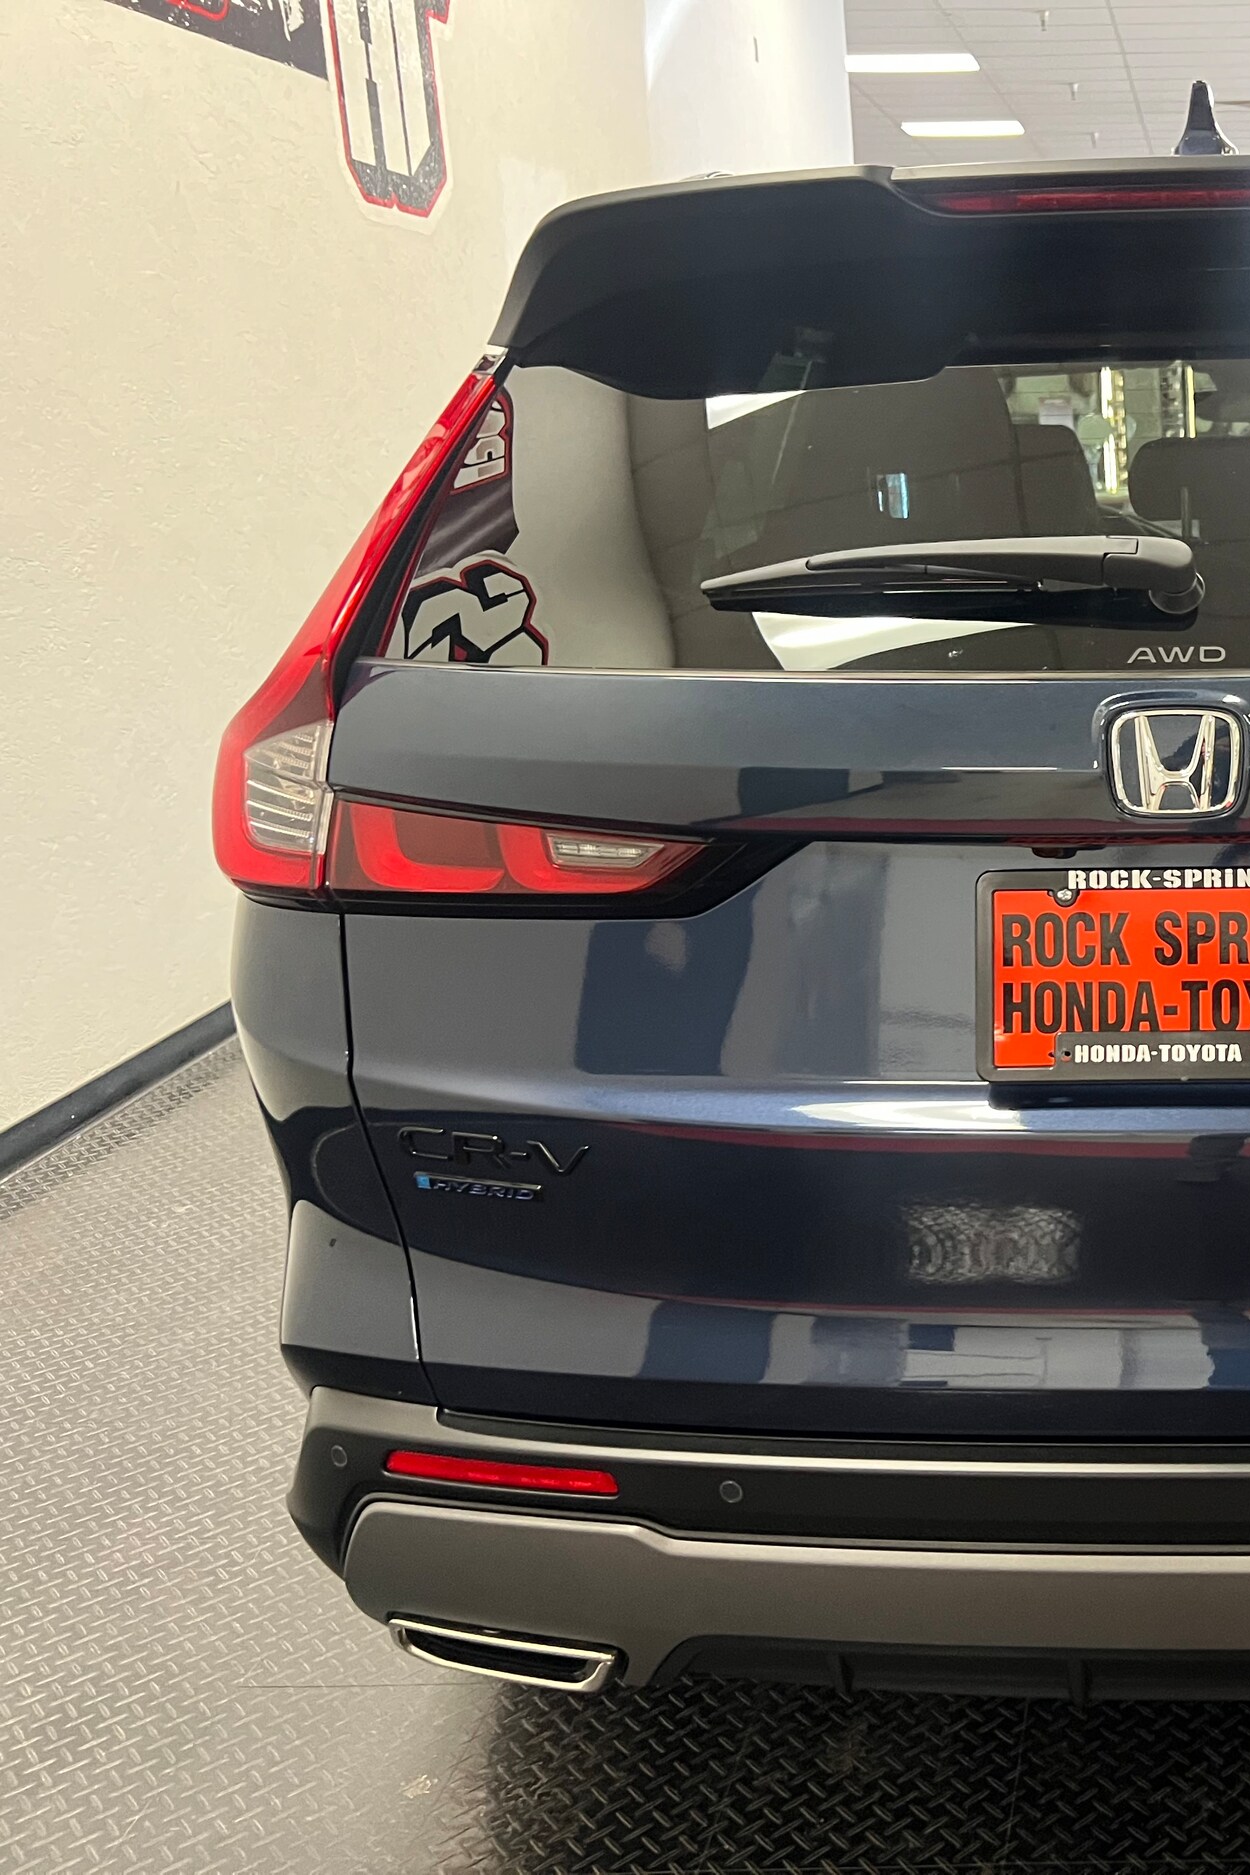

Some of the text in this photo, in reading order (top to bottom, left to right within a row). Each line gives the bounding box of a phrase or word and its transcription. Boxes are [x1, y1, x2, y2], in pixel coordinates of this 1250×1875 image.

[1127, 646, 1227, 664] AWD
[1002, 912, 1130, 967] ROCK
[1074, 1043, 1242, 1063] HONDA-TOYOTA
[398, 1126, 590, 1173] CR-V
[433, 1180, 534, 1200] HYBRID
